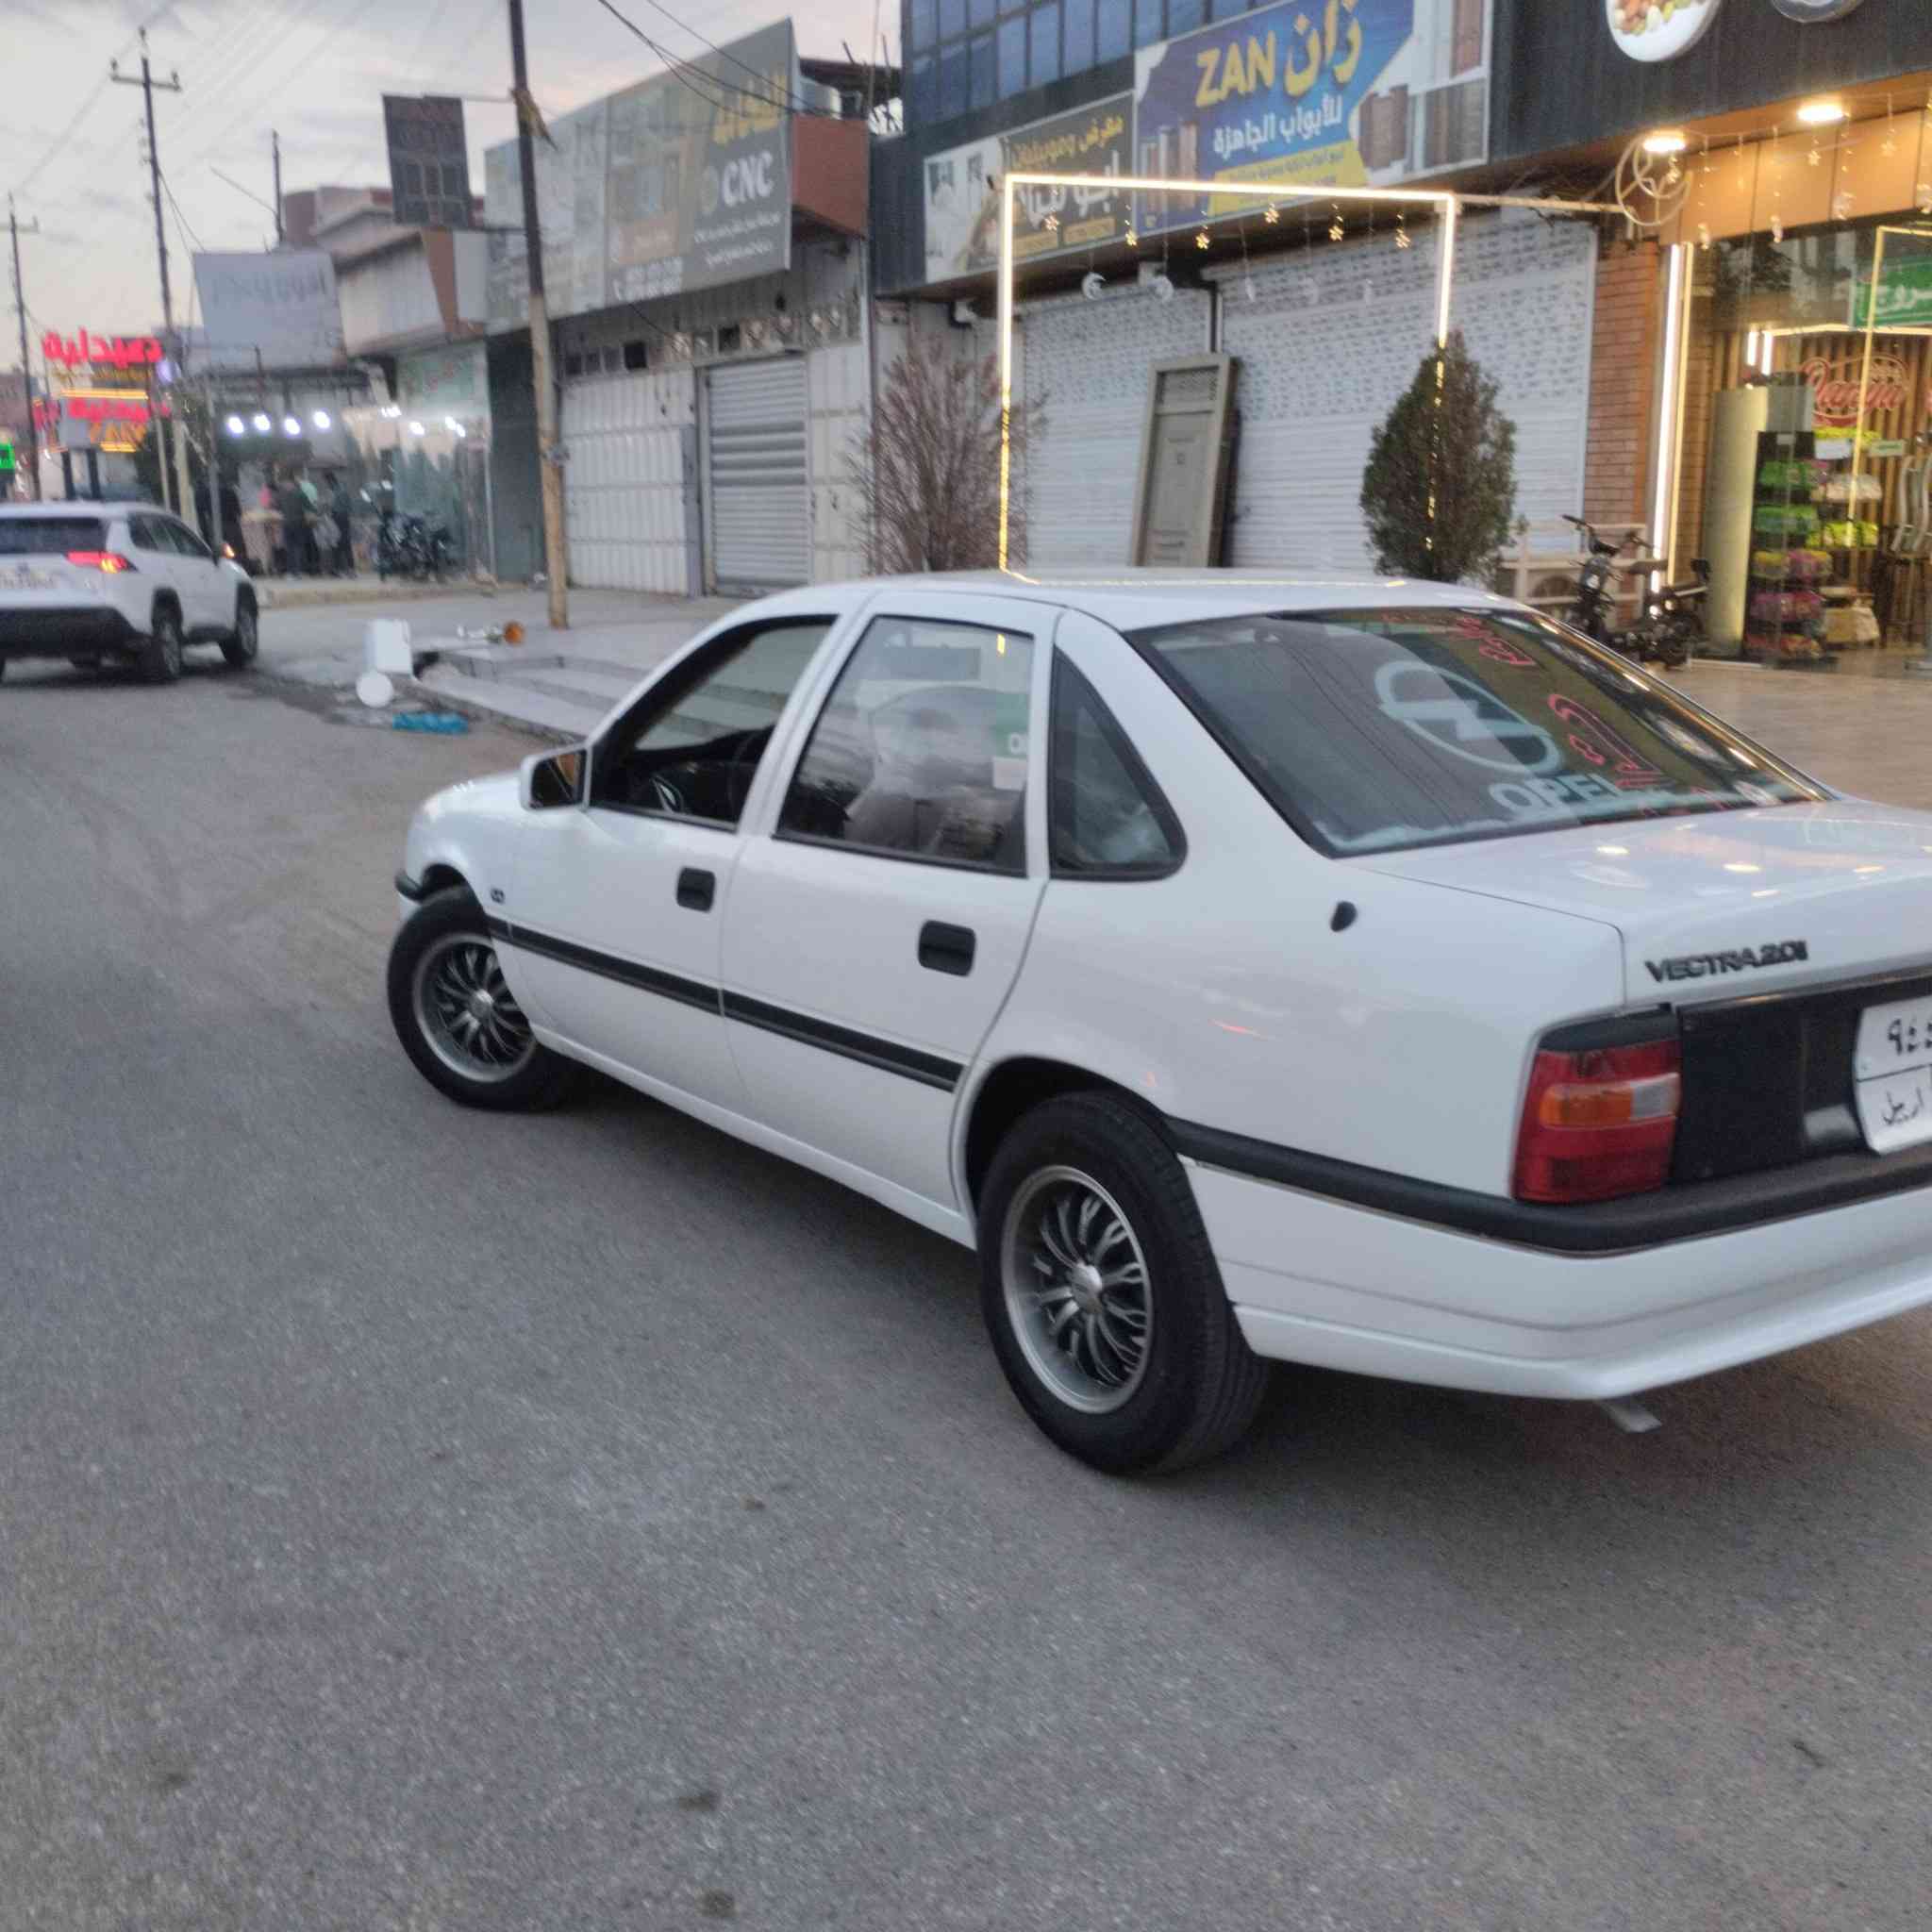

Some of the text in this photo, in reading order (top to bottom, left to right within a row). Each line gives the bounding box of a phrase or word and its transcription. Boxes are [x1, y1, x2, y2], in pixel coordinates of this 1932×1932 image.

[1195, 0, 1362, 108] ZAN زان
[722, 150, 775, 208] CNC
[1488, 772, 1640, 816] OPEL
[1644, 946, 1757, 982] VECTRA
